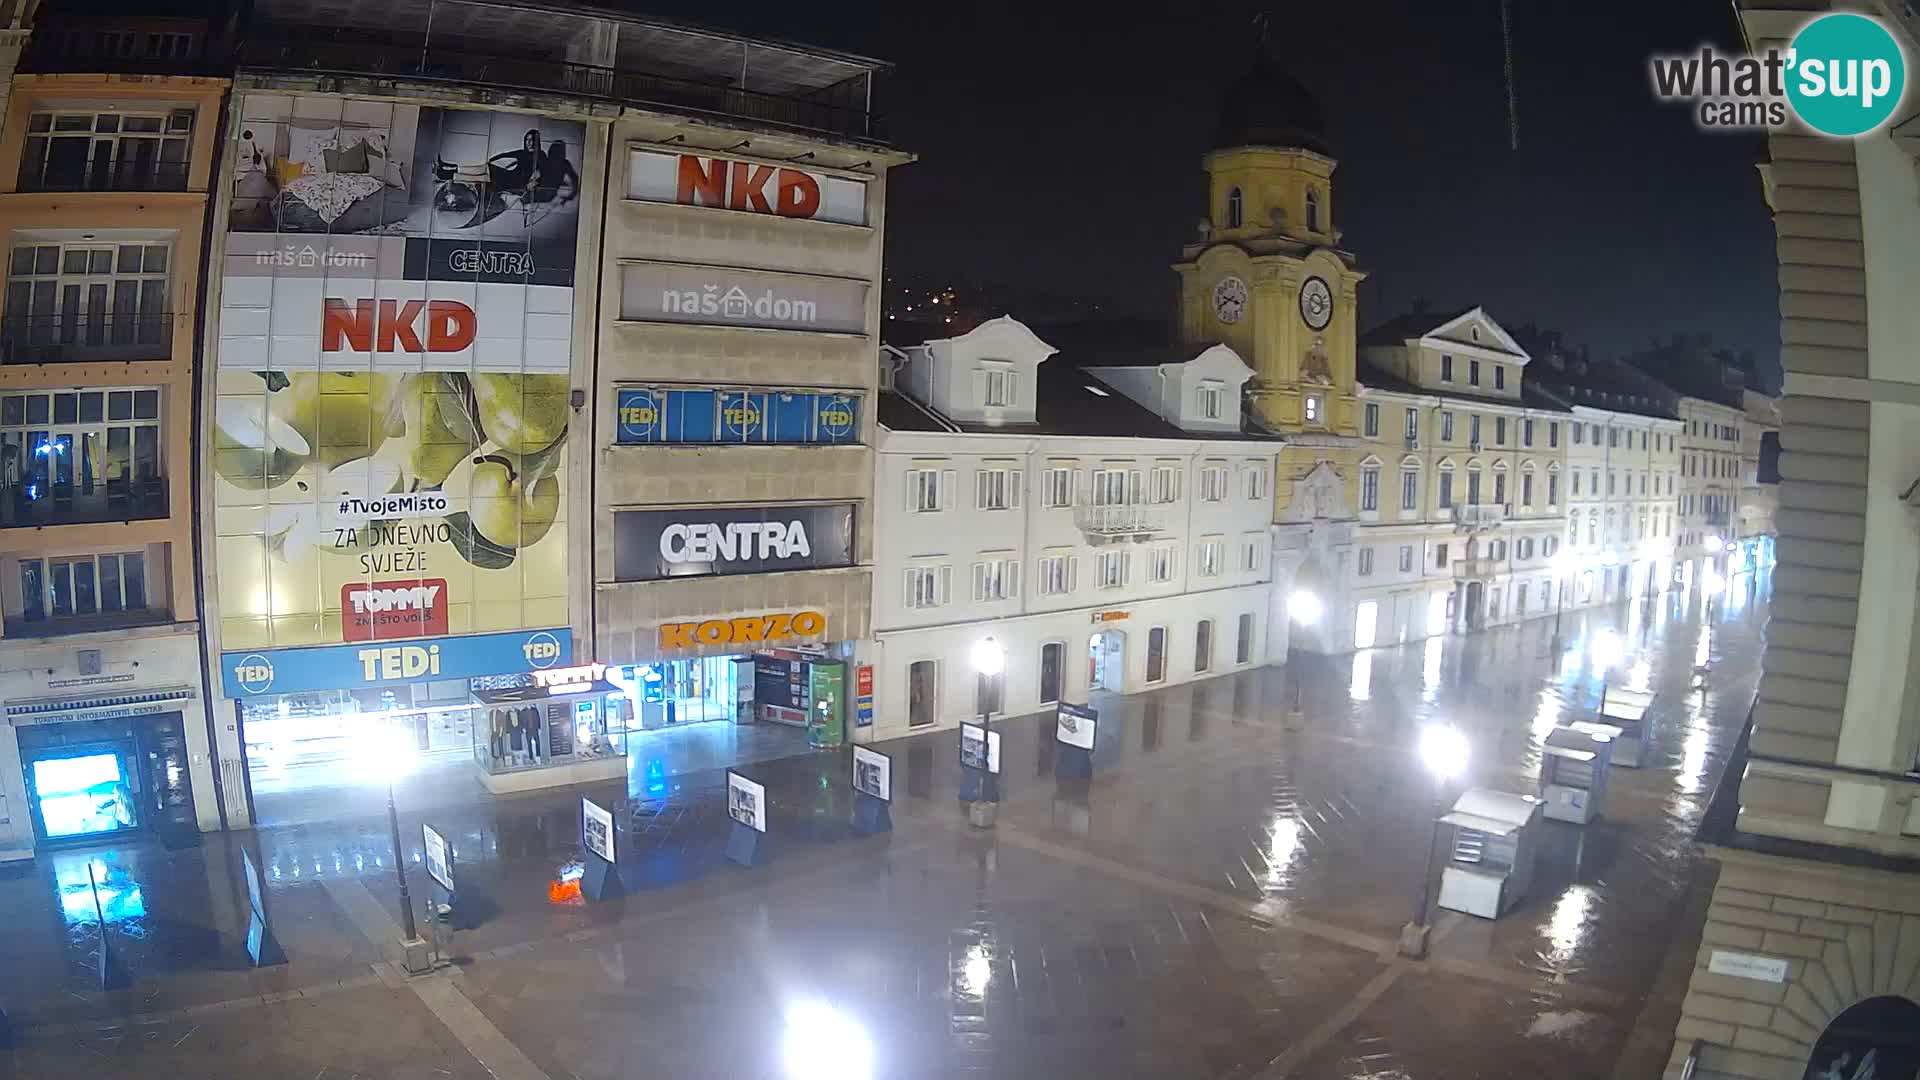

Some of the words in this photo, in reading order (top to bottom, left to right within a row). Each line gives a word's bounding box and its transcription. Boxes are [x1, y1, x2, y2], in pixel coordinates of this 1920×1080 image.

[677, 154, 820, 218] NKD
[256, 246, 297, 267] naš
[322, 247, 366, 268] dom
[449, 249, 535, 275] CENTRA
[662, 283, 718, 315] naš
[755, 289, 816, 322] dom
[322, 297, 477, 352] NKD
[620, 407, 658, 424] TEDi
[820, 410, 854, 426] TEDi
[339, 496, 447, 516] #TvojeMisto
[335, 527, 358, 548] ZA
[368, 523, 451, 547] DNEVNO
[660, 520, 810, 563] CENTRA
[360, 547, 427, 574] SVJEŽE
[349, 585, 440, 613] TOMMY
[659, 611, 825, 648] KORZO
[359, 645, 440, 681] TEDi
[522, 642, 560, 660] TEDi
[235, 665, 273, 683] TEDi
